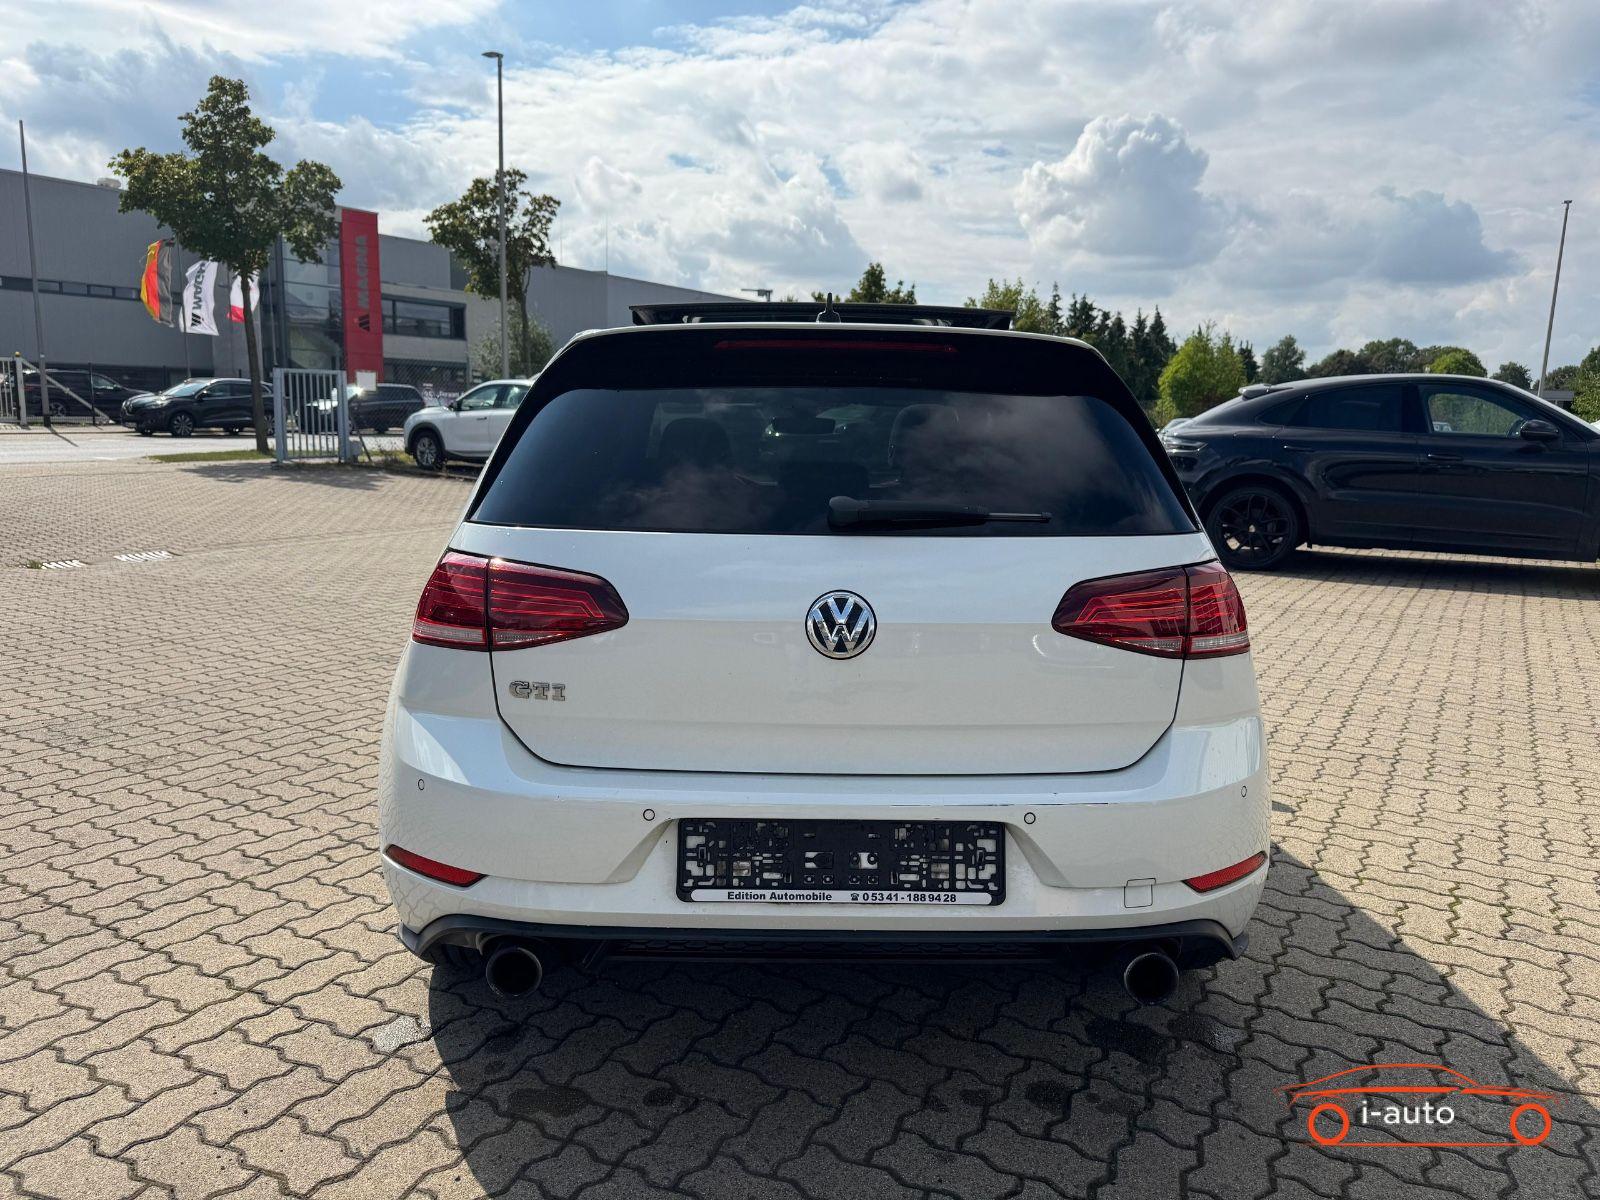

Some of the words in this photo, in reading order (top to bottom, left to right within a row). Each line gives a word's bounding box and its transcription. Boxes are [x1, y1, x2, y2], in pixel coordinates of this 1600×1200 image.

[808, 592, 874, 656] VW
[509, 680, 566, 701] GTI
[727, 891, 764, 901] Edition
[769, 891, 833, 902] Automobile
